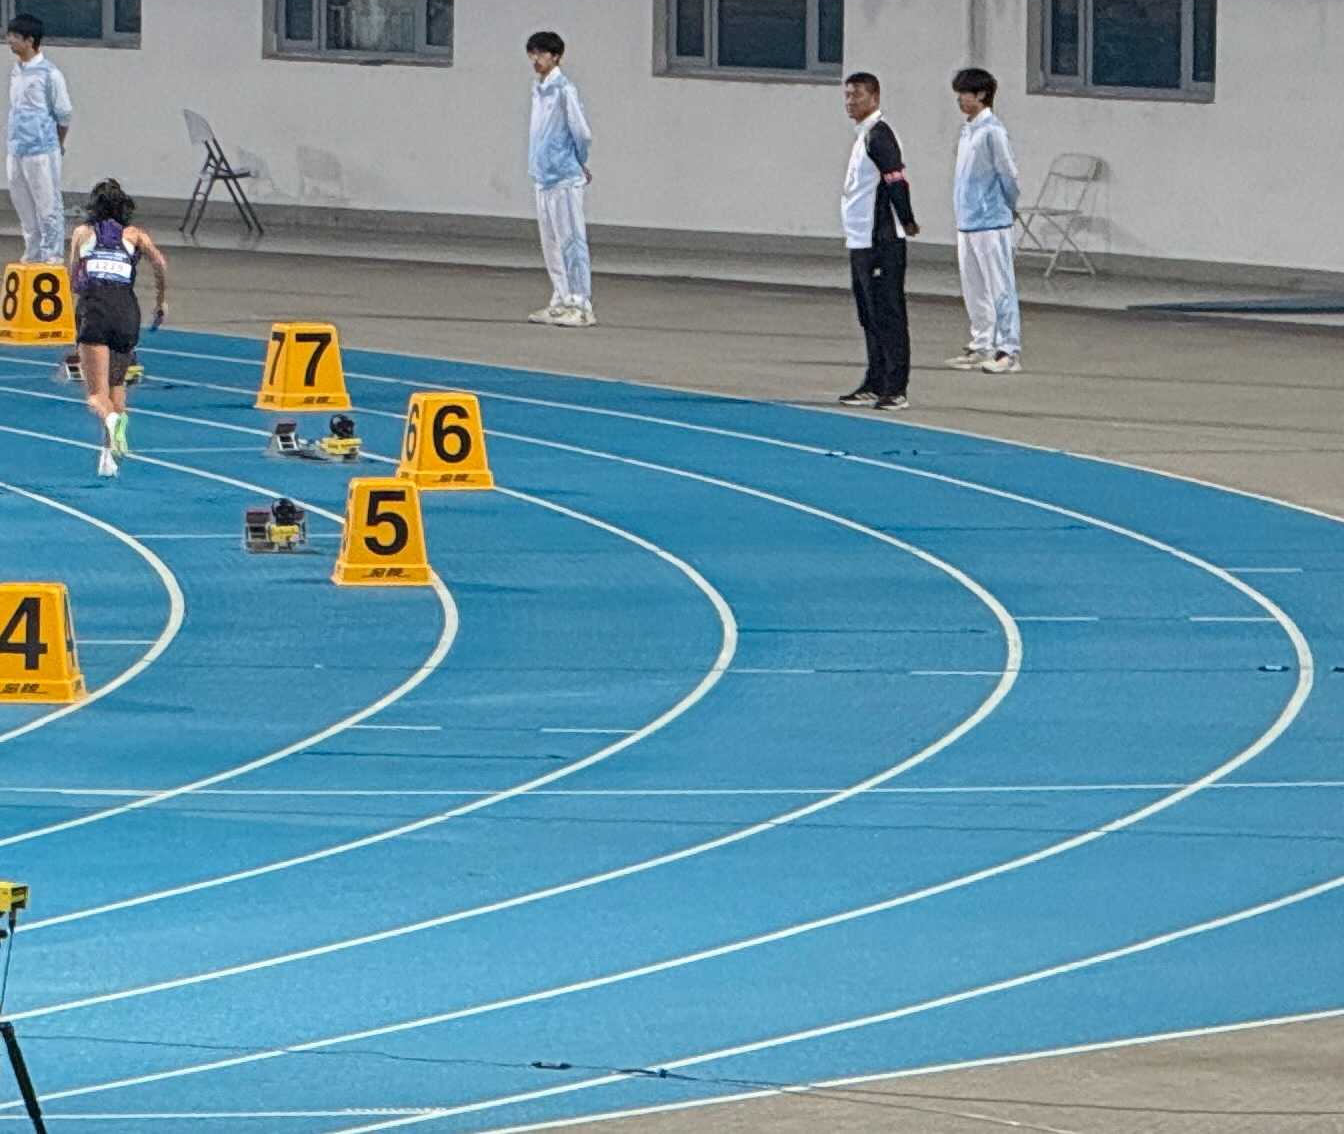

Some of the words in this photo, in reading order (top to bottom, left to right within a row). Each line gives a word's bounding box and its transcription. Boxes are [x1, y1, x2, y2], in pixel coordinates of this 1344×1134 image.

[2, 271, 20, 321] 8
[32, 272, 64, 322] 8
[269, 331, 286, 386] 7
[295, 333, 331, 387] 7
[406, 403, 420, 462] 6
[433, 404, 472, 464] 6
[363, 490, 409, 556] 5
